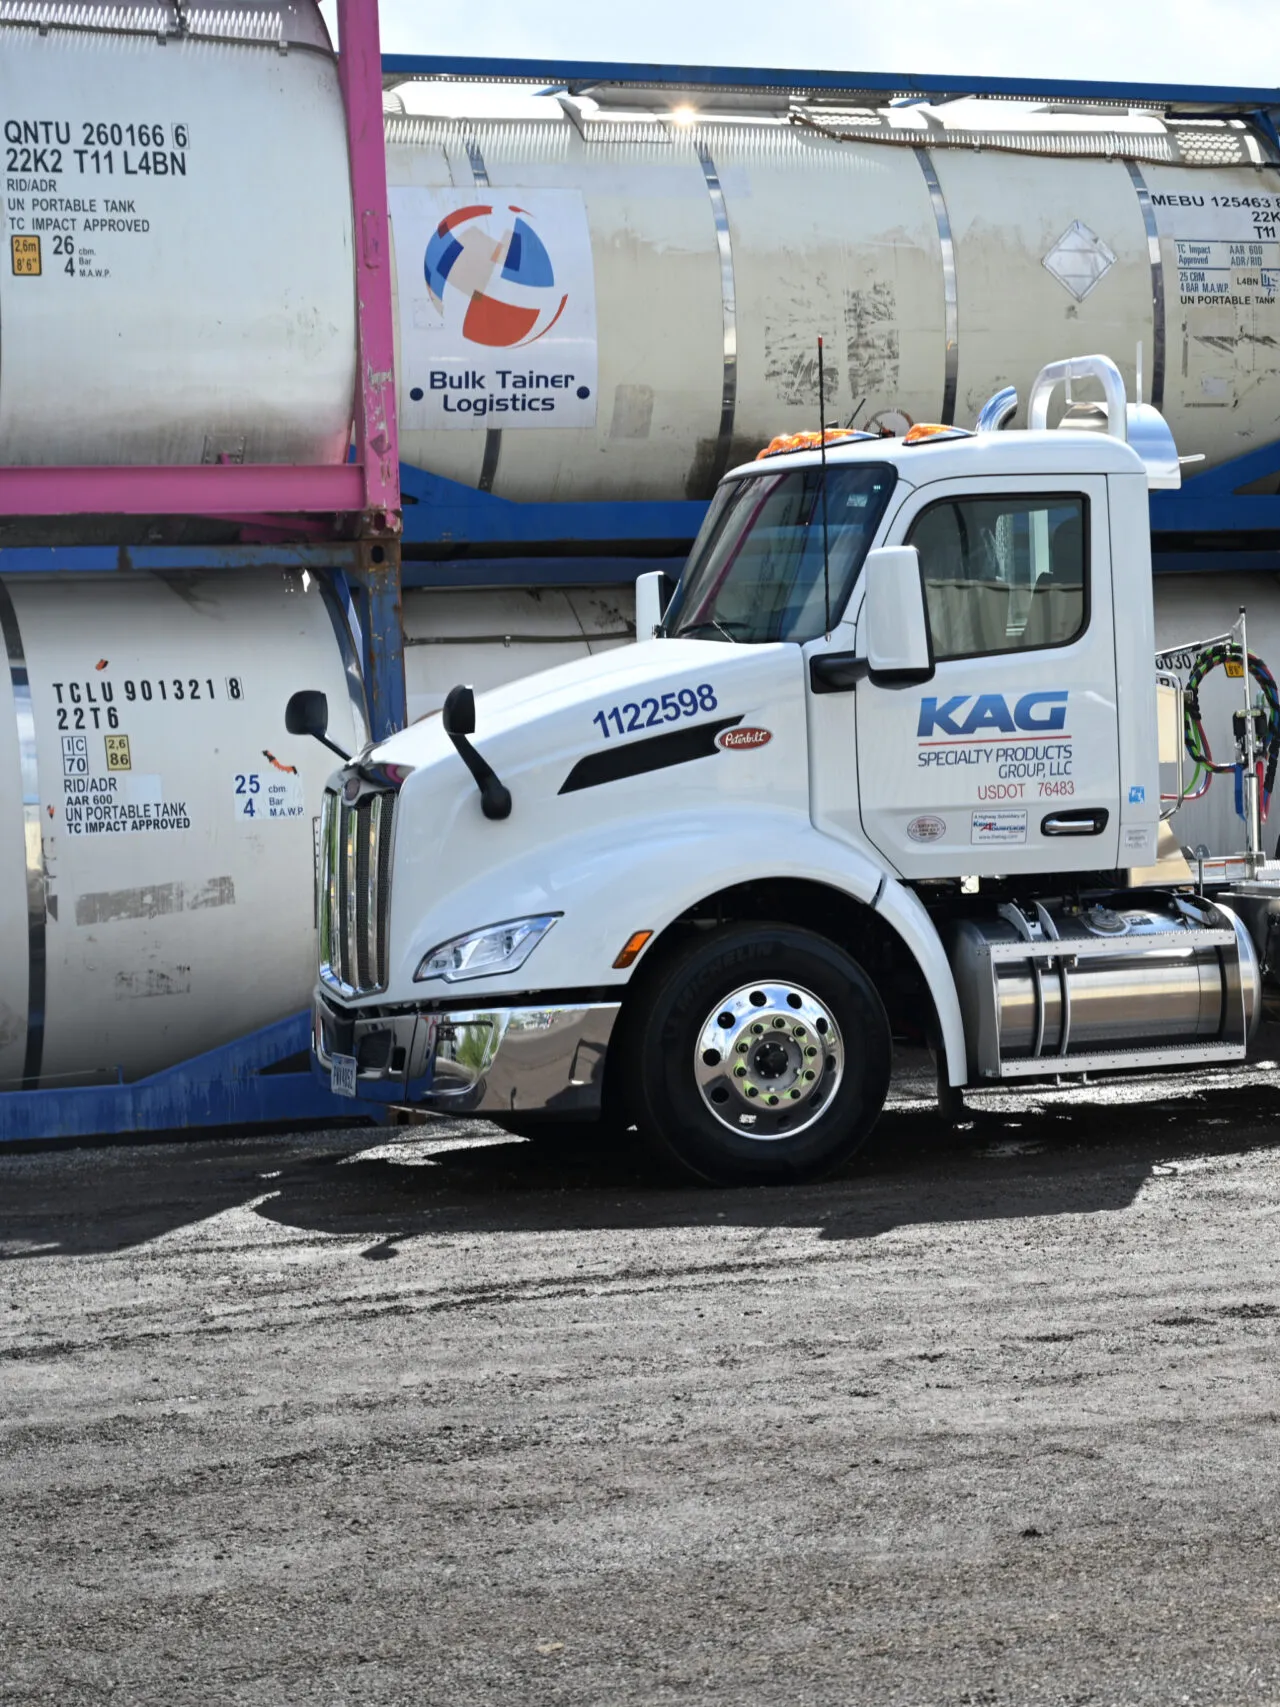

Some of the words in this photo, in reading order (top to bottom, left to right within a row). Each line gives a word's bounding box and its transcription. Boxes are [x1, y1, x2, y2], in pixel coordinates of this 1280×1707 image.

[4, 120, 71, 144] QNTU
[82, 122, 164, 147] 260166
[174, 124, 188, 147] 6
[6, 149, 63, 173] 22K2
[73, 150, 114, 174] T11
[123, 152, 187, 175] L4BN
[7, 179, 57, 192] RID/ADR
[8, 199, 25, 211] UN
[32, 199, 97, 213] PORTABLE
[103, 200, 136, 213] TANK
[1151, 194, 1204, 207] MEBU
[1211, 196, 1271, 208] 125463
[9, 217, 25, 230] TC
[32, 218, 77, 231] IMPACT
[83, 219, 150, 233] APPROVED
[1253, 226, 1276, 239] T11
[53, 235, 75, 255] 26
[1177, 244, 1186, 253] TC
[1229, 245, 1245, 255] AAR
[64, 257, 75, 277] 4
[79, 257, 91, 265] Bar
[1178, 255, 1209, 267] Approved
[1231, 256, 1263, 267] ADR/RID
[1179, 271, 1189, 282] 25
[1236, 277, 1259, 286] L4BN
[1180, 296, 1195, 305] UN
[1197, 295, 1251, 305] PORTABLE
[1255, 296, 1276, 304] TANK
[429, 370, 485, 389] Bulk
[496, 370, 575, 388] Tainer
[443, 394, 555, 416] Logistics
[52, 681, 114, 703] TCLU
[124, 679, 215, 701] 901321
[228, 677, 241, 699] 8
[56, 706, 119, 730] 22T6
[593, 683, 718, 738] 1122598
[917, 690, 1069, 737] KAG
[725, 730, 768, 747] Peterbilt
[66, 757, 86, 772] 70
[110, 753, 129, 766] 86
[918, 748, 993, 767] SPECIALTY
[996, 745, 1072, 763] PRODUCTS
[999, 762, 1046, 779] GROUP,
[1050, 760, 1072, 776] LLC
[64, 777, 118, 793] RID/ADR
[235, 774, 260, 794] 25
[977, 783, 1026, 800] USDOT
[1037, 780, 1075, 797] 76483
[66, 795, 89, 806] AAR
[93, 794, 113, 805] 600
[243, 797, 255, 817] 4
[269, 797, 284, 806] Bar
[65, 807, 82, 821] UN
[86, 804, 151, 821] PORTABLE
[154, 802, 187, 818] TANK
[67, 822, 81, 834] TC
[85, 820, 127, 833] IMPACT
[131, 818, 191, 831] APPROVED
